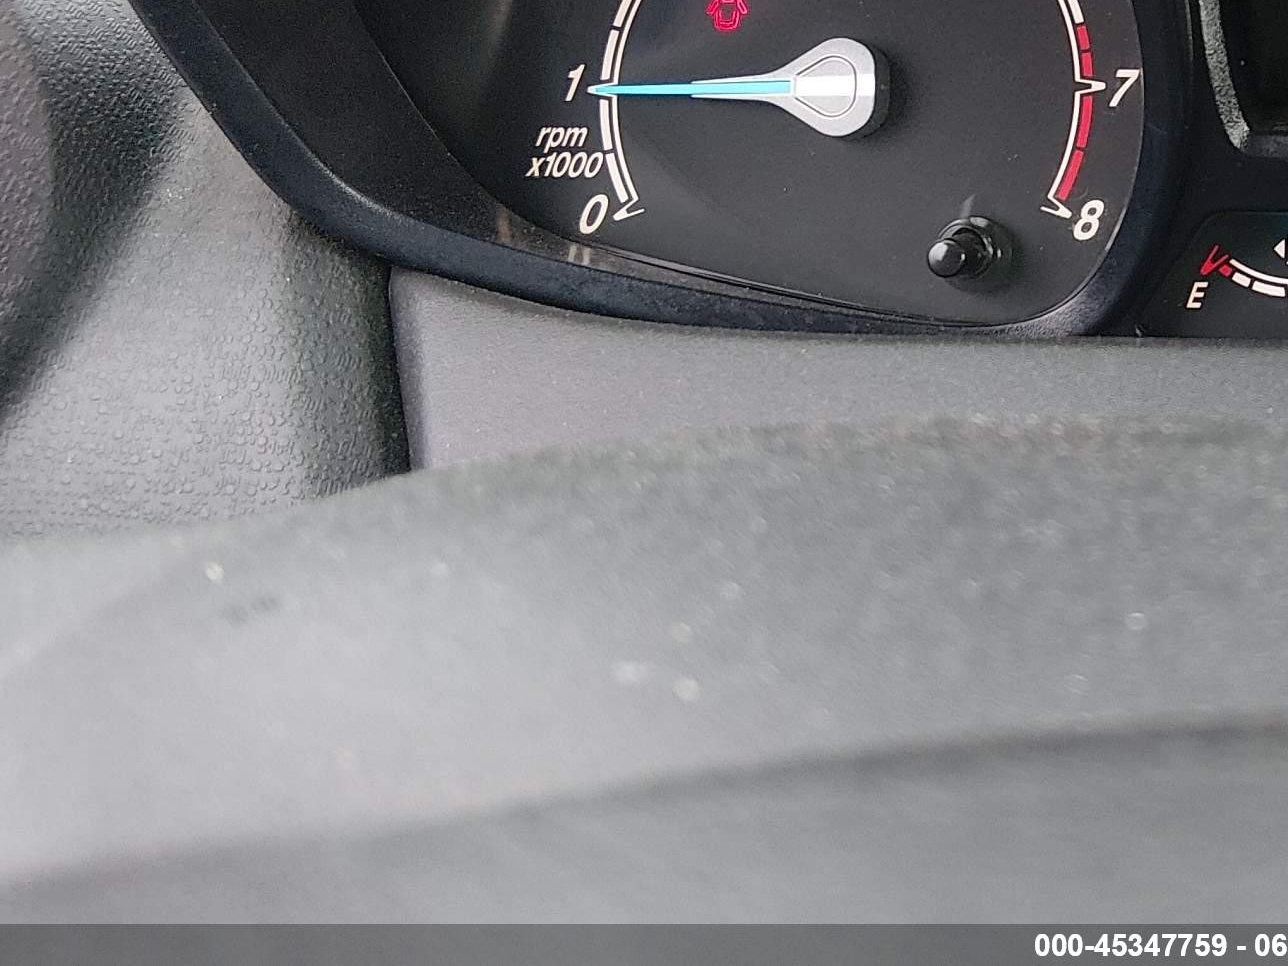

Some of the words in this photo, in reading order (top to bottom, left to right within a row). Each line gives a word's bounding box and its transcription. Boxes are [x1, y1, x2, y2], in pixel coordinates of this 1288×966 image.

[564, 65, 585, 101] 1
[1109, 69, 1141, 107] 7
[535, 126, 587, 149] rpm
[525, 152, 603, 179] x1000
[579, 195, 609, 234] 0
[1074, 200, 1105, 240] 8
[1186, 282, 1208, 309] E
